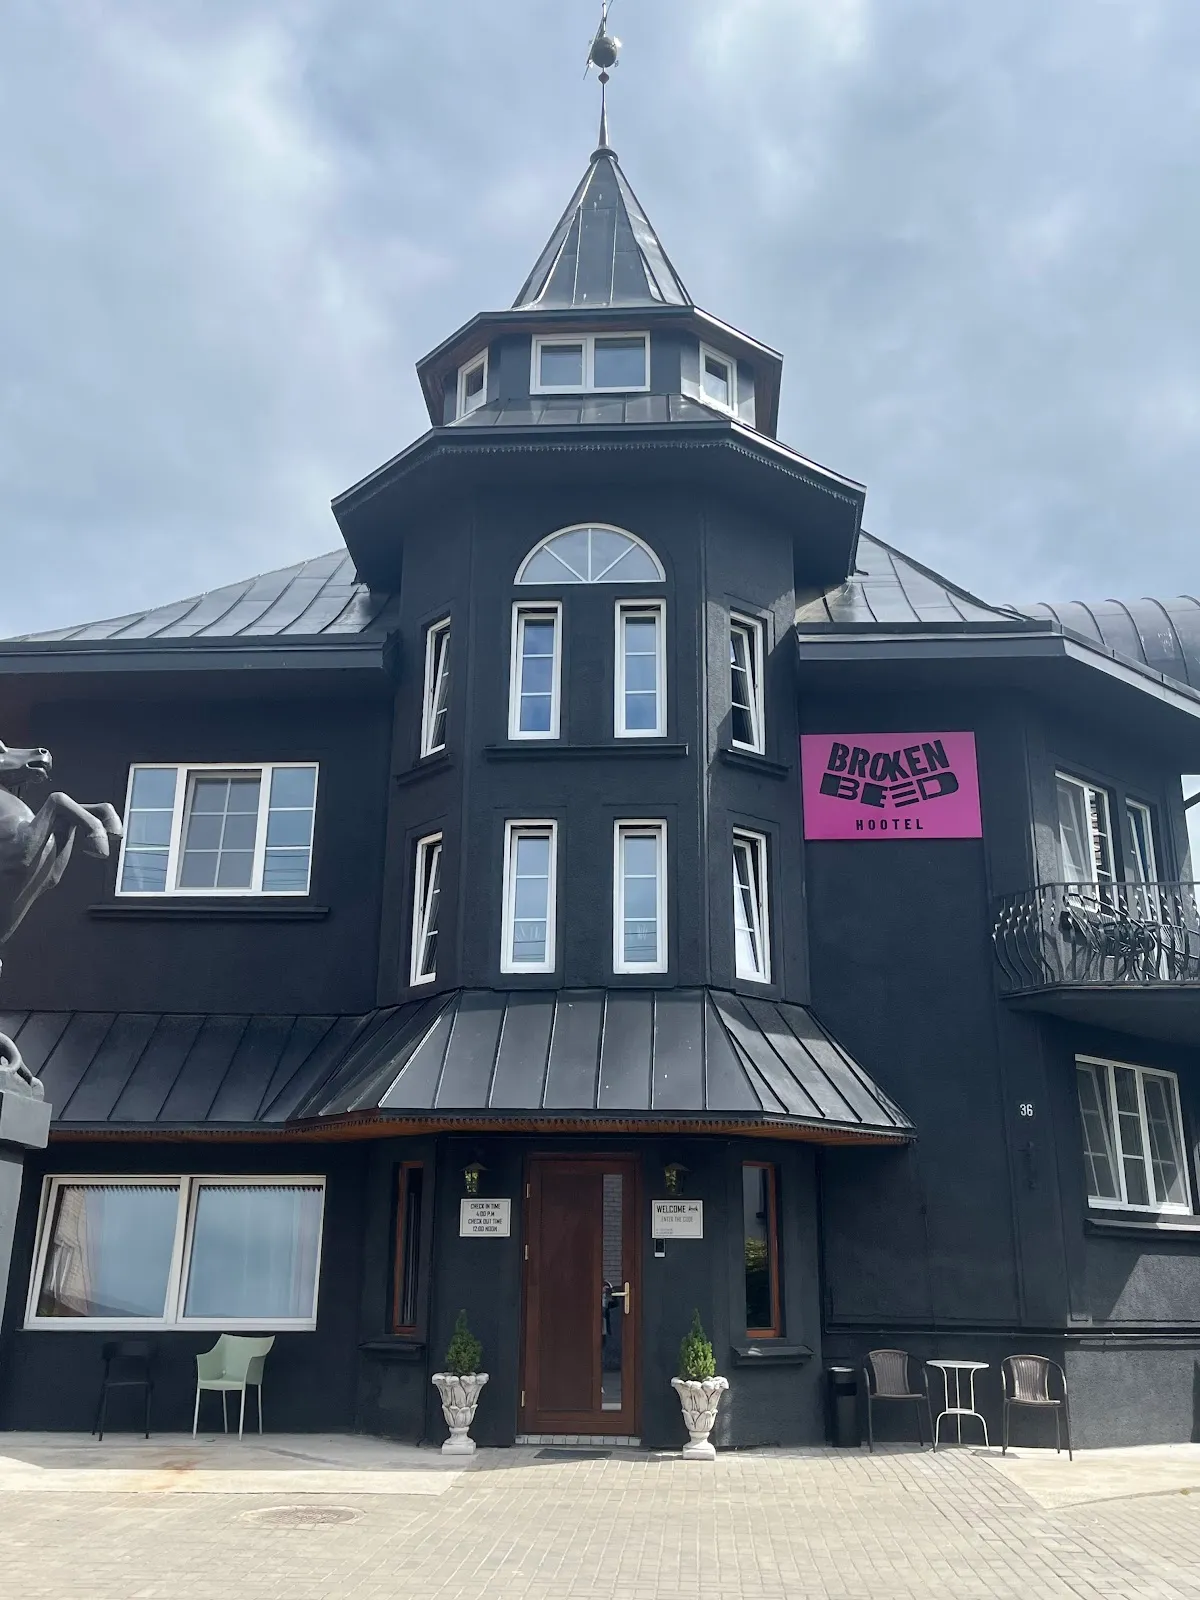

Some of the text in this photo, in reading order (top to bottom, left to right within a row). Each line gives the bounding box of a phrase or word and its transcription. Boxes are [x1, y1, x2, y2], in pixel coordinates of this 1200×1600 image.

[827, 739, 950, 782] BROKEN
[856, 818, 924, 830] HOOTEL
[1020, 1103, 1033, 1116] 36
[656, 1205, 686, 1213] WELCOME
